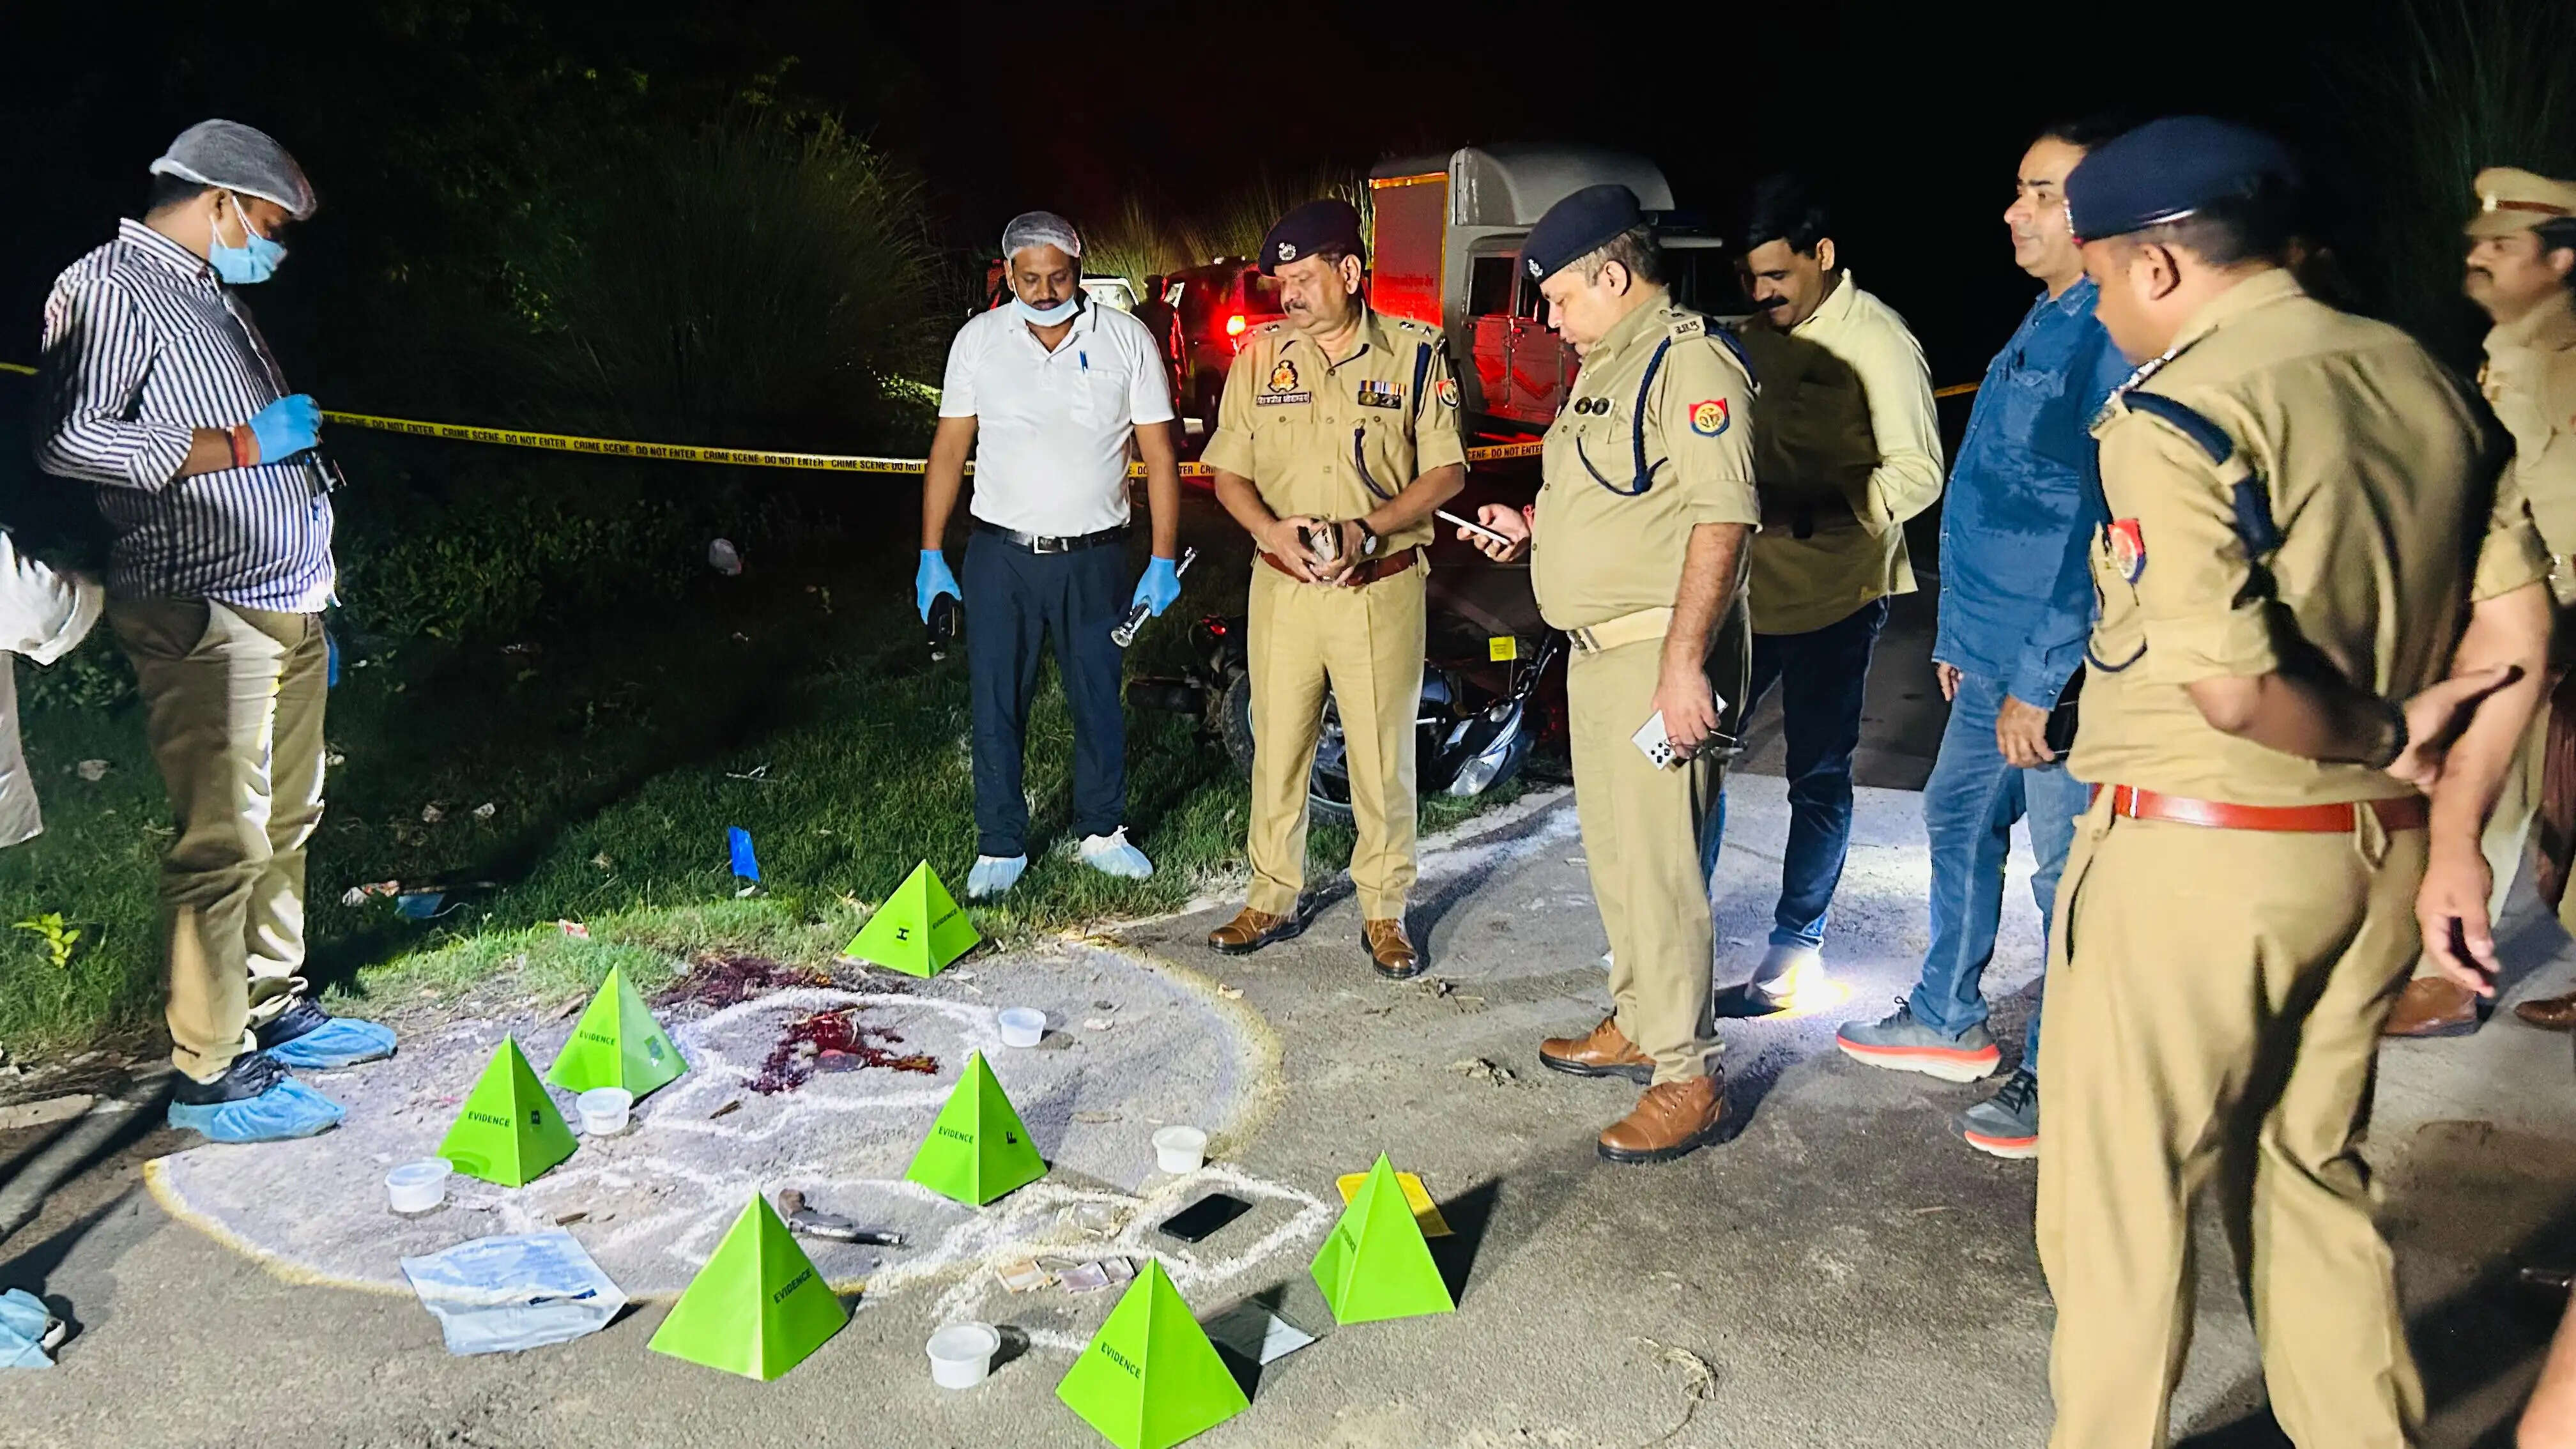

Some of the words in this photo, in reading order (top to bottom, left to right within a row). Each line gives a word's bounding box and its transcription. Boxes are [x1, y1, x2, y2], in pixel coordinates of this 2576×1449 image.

[387, 421, 404, 431] NOT
[407, 423, 435, 434] ENTER
[442, 427, 470, 438] CRIME
[505, 434, 518, 444] DO
[519, 435, 537, 445] NOT
[539, 437, 566, 448] ENTER
[574, 440, 601, 452] CRIME
[636, 446, 648, 456] DO
[650, 447, 666, 456] NOT
[670, 448, 696, 459] ENTER
[703, 450, 729, 461] CRIME
[765, 456, 777, 464] DO
[779, 456, 794, 466] NOT
[797, 457, 824, 467] ENTER
[1491, 448, 1501, 457] DO
[1504, 447, 1519, 457] NOT
[933, 908, 958, 930] EVIDENCE
[896, 927, 910, 942] H
[579, 1030, 616, 1046] EVIDENCE
[468, 1110, 510, 1128] EVIDENCE
[938, 1126, 974, 1144] EVIDENCE
[1006, 1131, 1017, 1144] F
[773, 1267, 813, 1305] EVIDENCE
[1101, 1342, 1142, 1379] EVIDENCE
